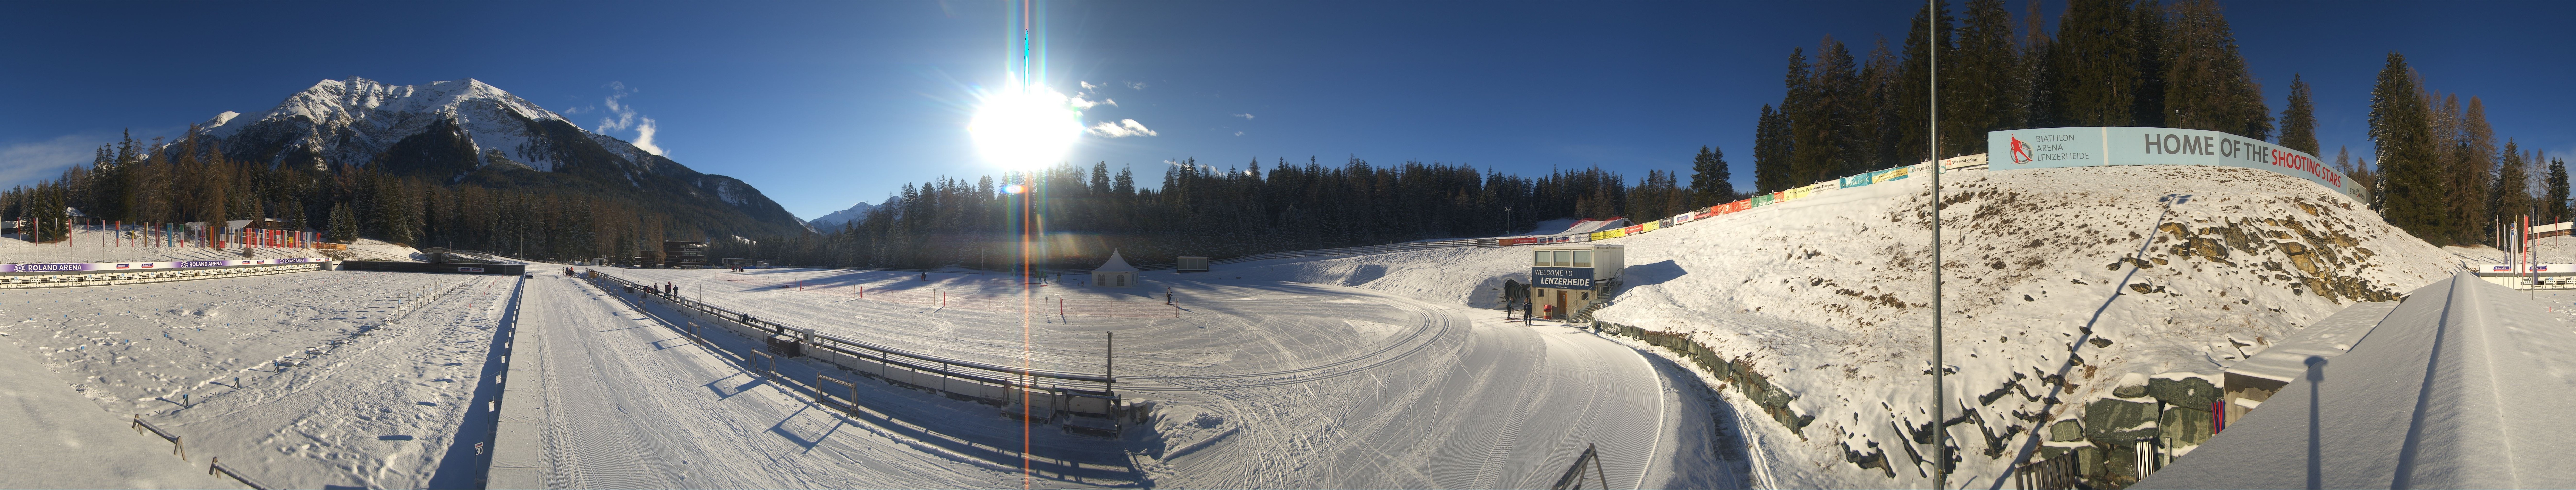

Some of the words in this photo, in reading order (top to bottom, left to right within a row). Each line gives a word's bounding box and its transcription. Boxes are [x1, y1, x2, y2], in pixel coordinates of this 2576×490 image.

[2036, 134, 2074, 143] BIATHLON
[2038, 152, 2089, 161] LENZERHEIDE
[2145, 133, 2214, 156] HOME
[2220, 138, 2240, 158] OF
[2244, 142, 2268, 164] THE
[2272, 149, 2320, 177] SHOOTING
[2322, 167, 2341, 188] STARS
[1541, 277, 1590, 286] LENZERHEIDE
[475, 446, 483, 455] 30
